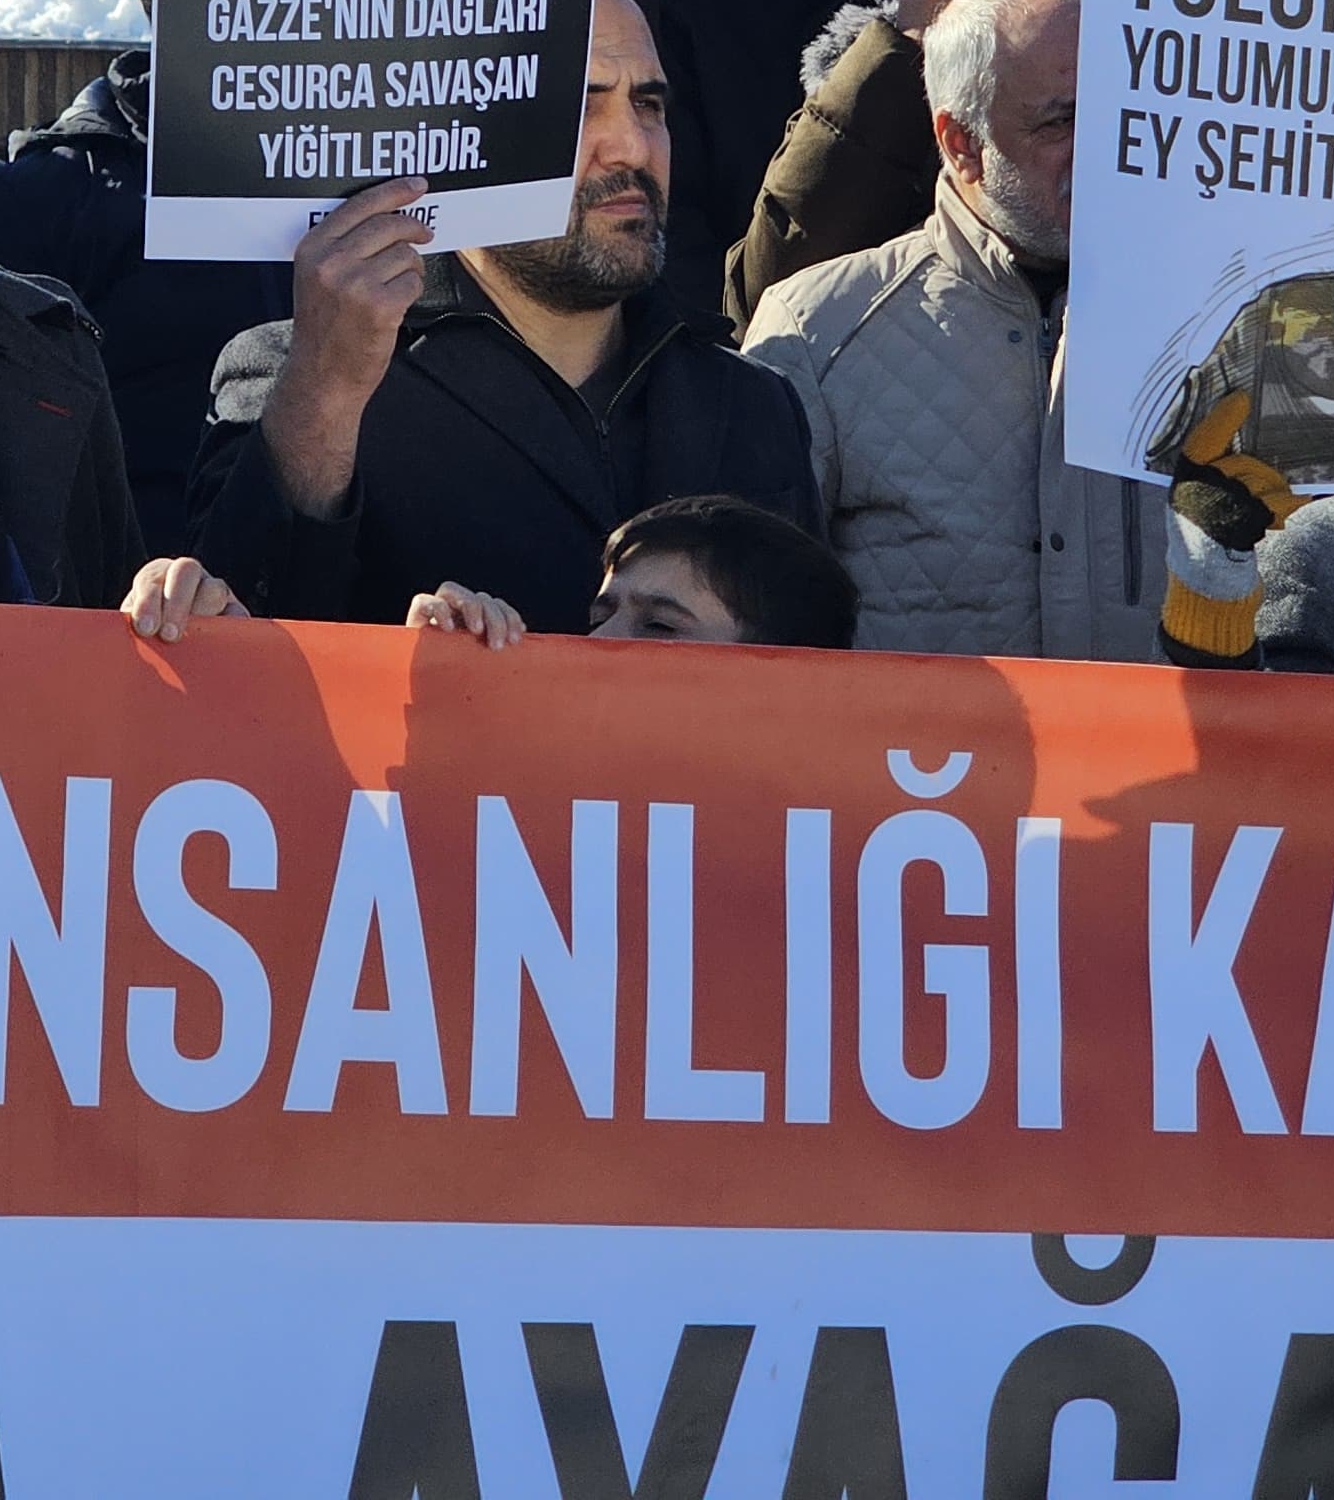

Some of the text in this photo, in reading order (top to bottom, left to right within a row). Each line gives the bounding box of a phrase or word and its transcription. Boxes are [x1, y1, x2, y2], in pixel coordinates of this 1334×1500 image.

[211, 54, 538, 112] CESURCA SAVAŞAN
[258, 119, 488, 179] YİĞİTLERİDİR.
[1117, 107, 1183, 180] EY
